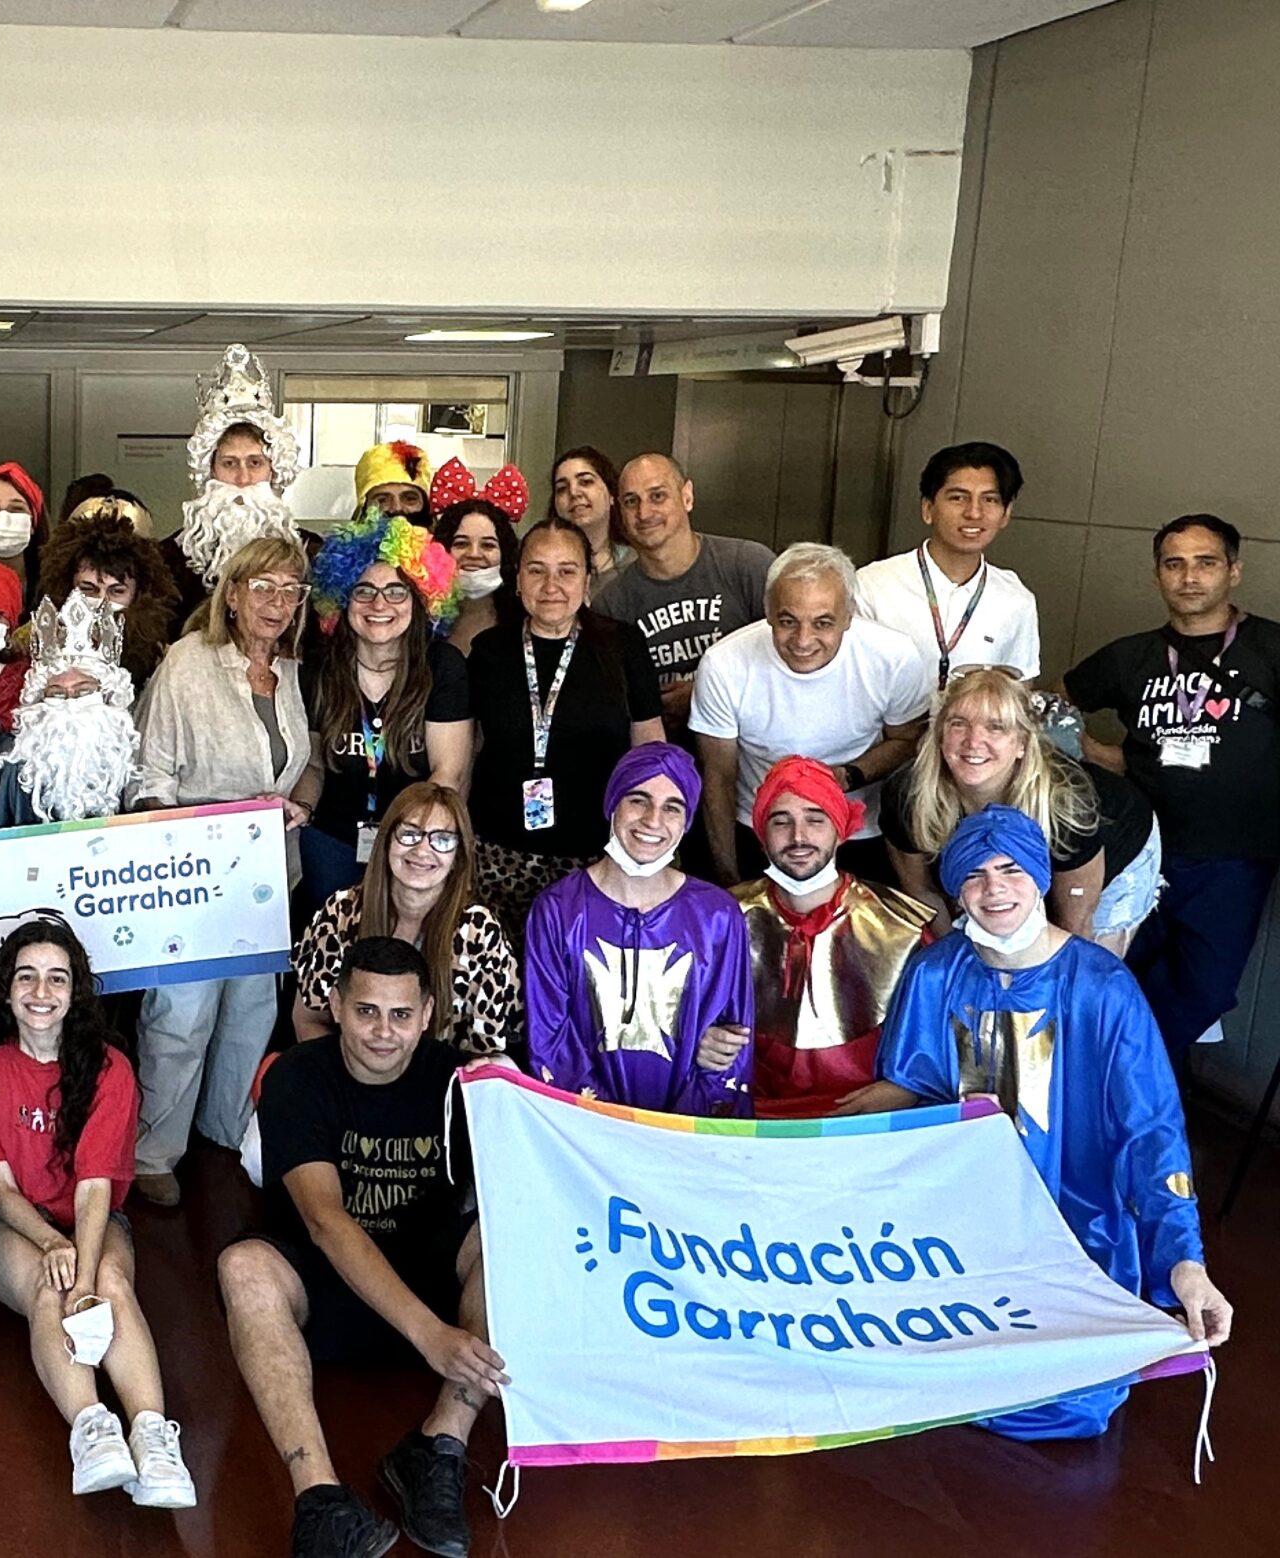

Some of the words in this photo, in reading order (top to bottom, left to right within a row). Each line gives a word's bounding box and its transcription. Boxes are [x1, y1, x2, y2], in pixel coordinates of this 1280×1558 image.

[637, 594, 722, 639] LIBERTÉ
[70, 852, 211, 891] Fundación
[74, 885, 209, 917] Garrahan
[345, 1181, 418, 1215] RANDE
[608, 1196, 965, 1286] Fundación
[623, 1271, 1000, 1352] Garrahan
